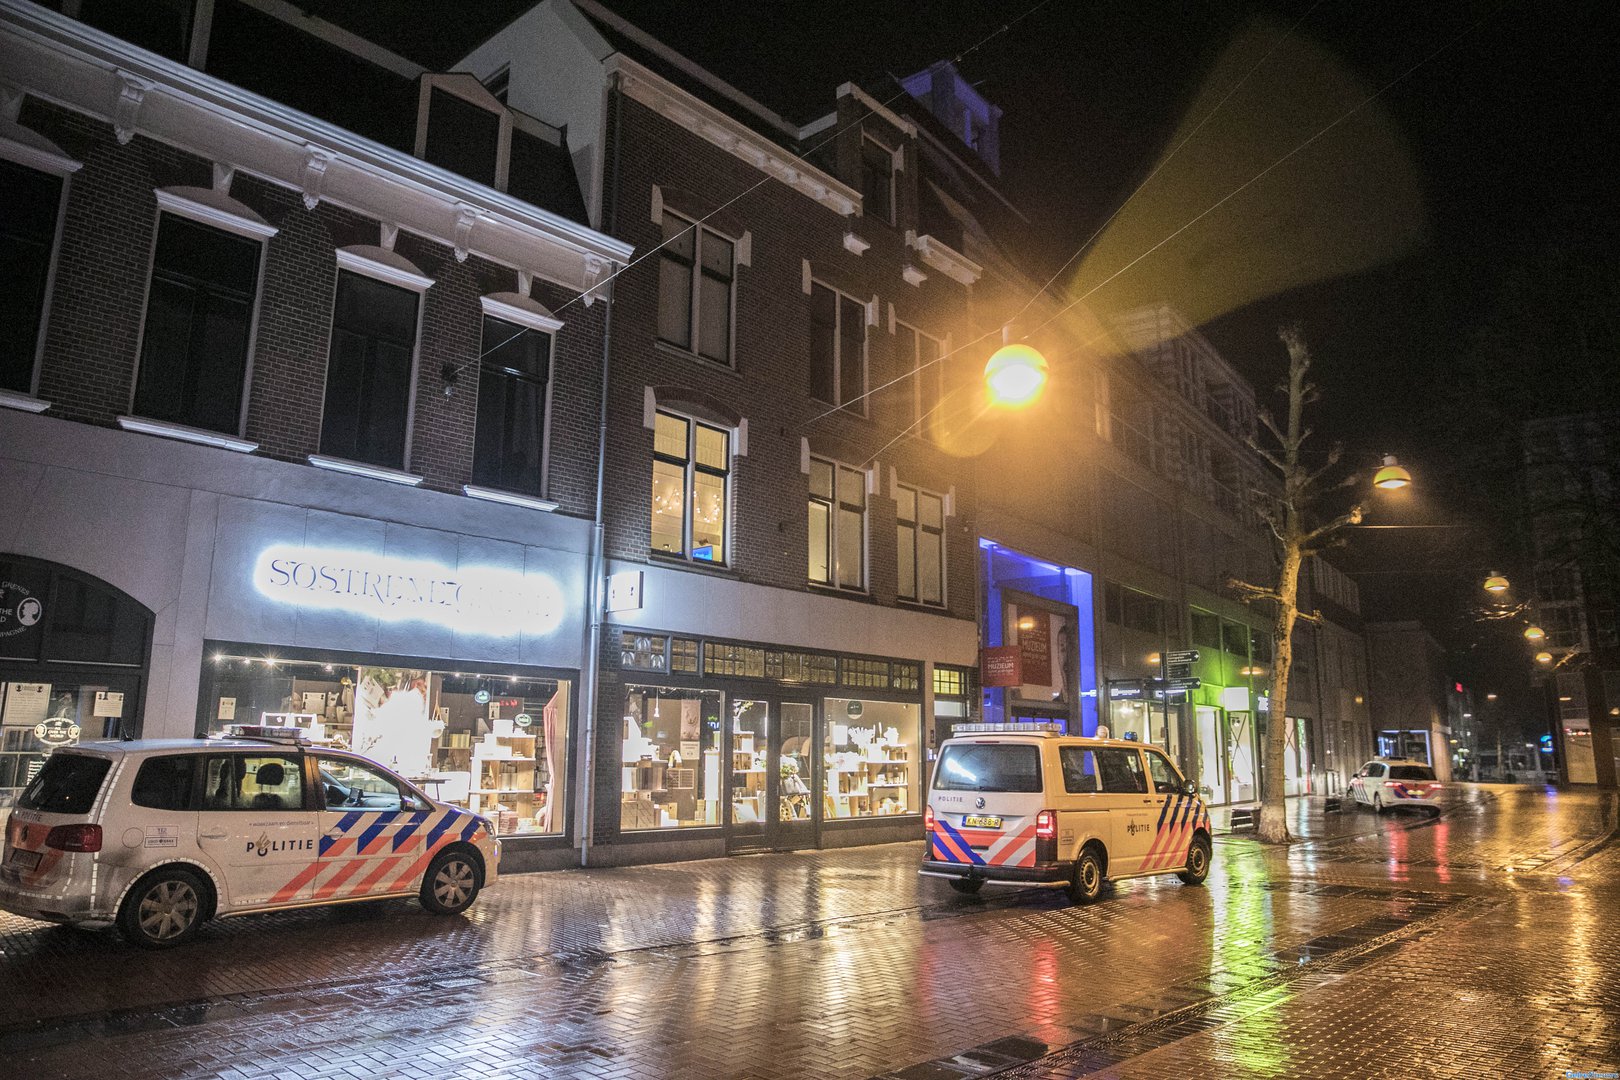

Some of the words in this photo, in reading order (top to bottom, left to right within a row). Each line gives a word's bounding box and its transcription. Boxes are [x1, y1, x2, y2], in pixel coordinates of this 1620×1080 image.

[987, 662, 1014, 670] MUZIEUM
[1127, 824, 1150, 836] POLITIE
[246, 839, 313, 857] POLITIE
